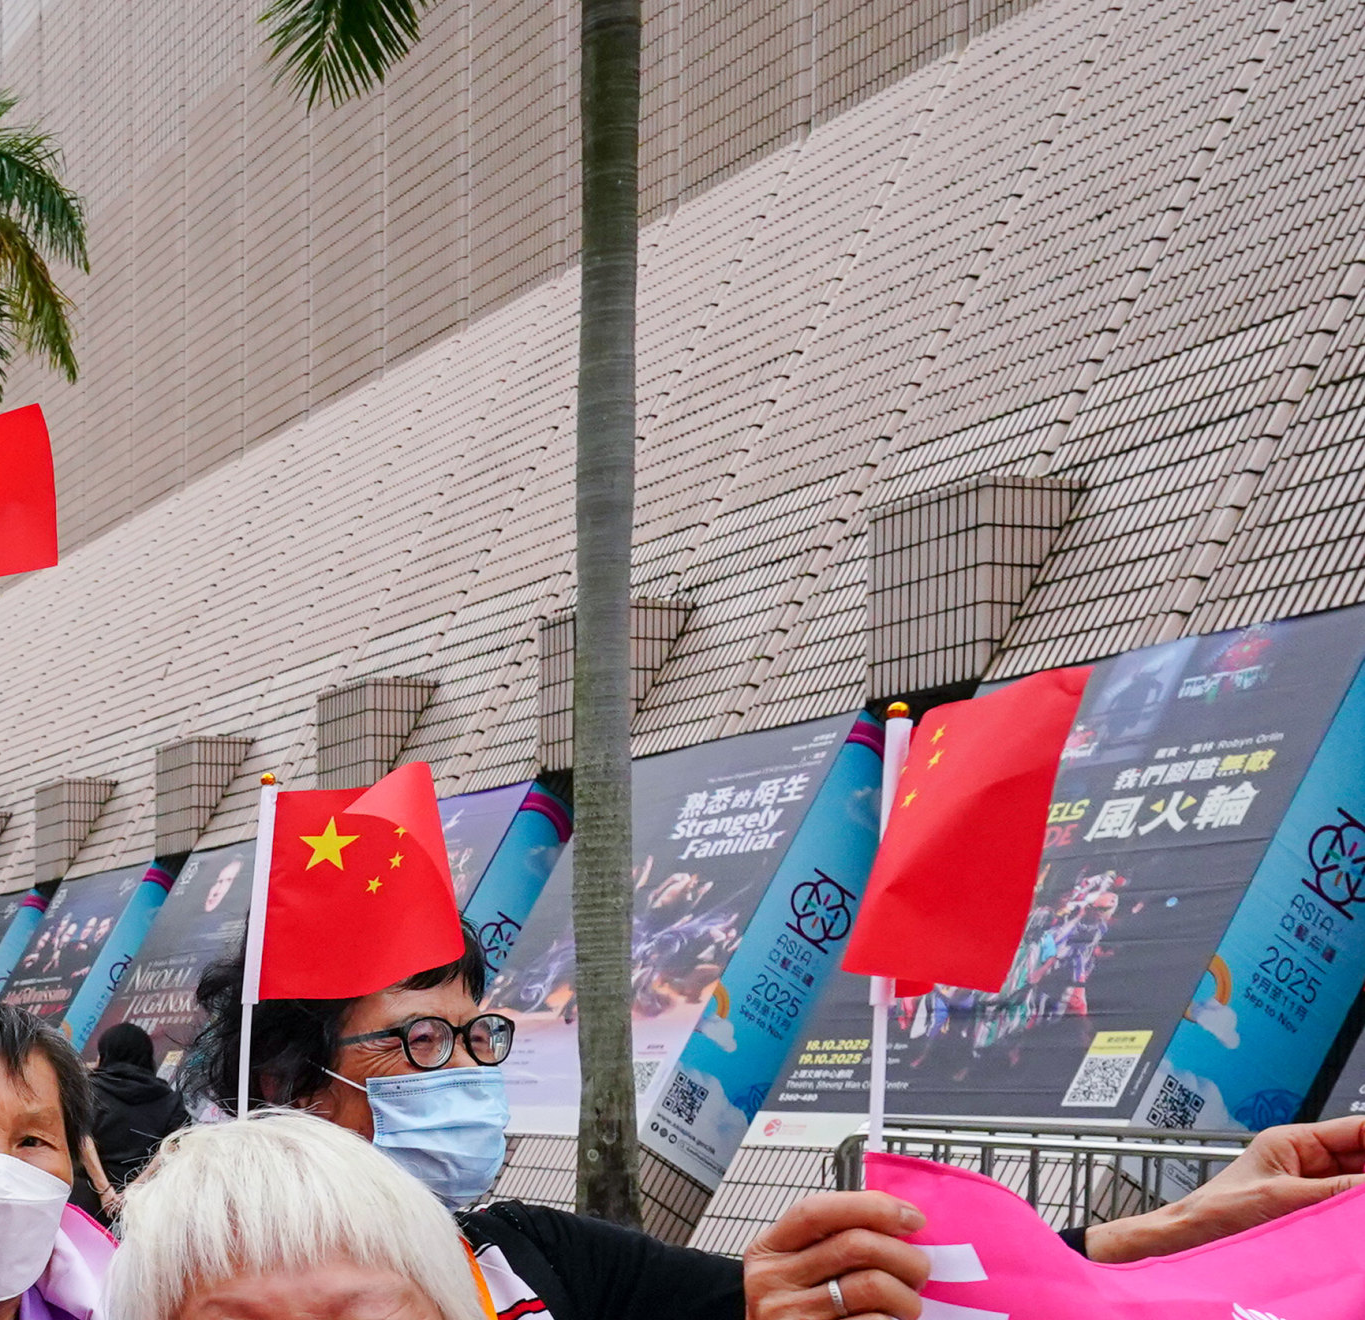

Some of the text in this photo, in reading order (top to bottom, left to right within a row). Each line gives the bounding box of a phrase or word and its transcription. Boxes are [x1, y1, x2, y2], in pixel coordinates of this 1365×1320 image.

[677, 772, 810, 820] 熟悉的陌生
[1083, 780, 1260, 843] 風火輪
[669, 805, 784, 840] Strangely
[679, 829, 785, 860] Familiar
[752, 974, 802, 1018] 2025
[1252, 972, 1309, 1022] 9月至11月
[1259, 946, 1322, 1004] 2025
[1244, 988, 1263, 1008] Sep
[1277, 1012, 1298, 1034] Nov
[798, 1052, 863, 1065] 19.10.2025
[806, 1039, 870, 1051] 18.10.2025
